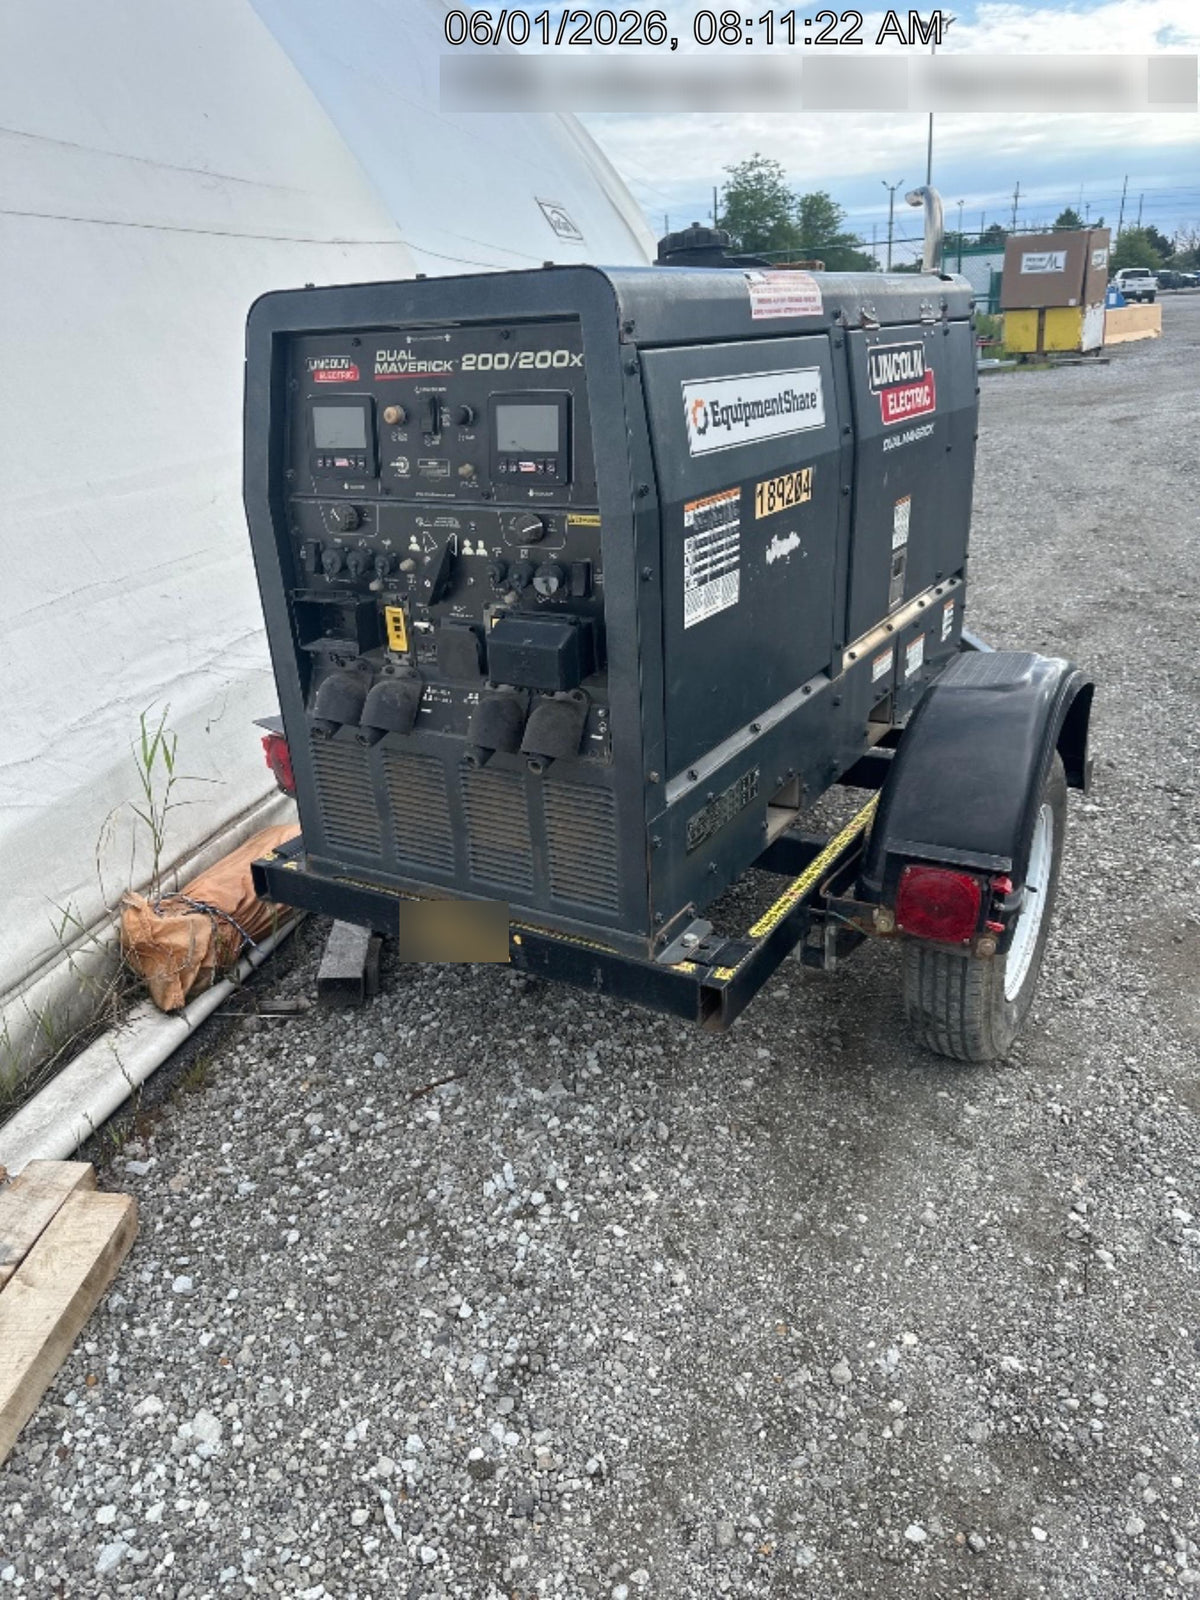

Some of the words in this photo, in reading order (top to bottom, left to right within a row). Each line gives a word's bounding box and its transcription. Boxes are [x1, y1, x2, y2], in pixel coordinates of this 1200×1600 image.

[374, 360, 453, 374] MAVERICK
[376, 350, 416, 361] DUAL
[871, 350, 923, 386] LINCOLN
[709, 389, 817, 430] EquipmentShare
[887, 386, 931, 415] ELECTRIC
[757, 468, 811, 514] 189204
